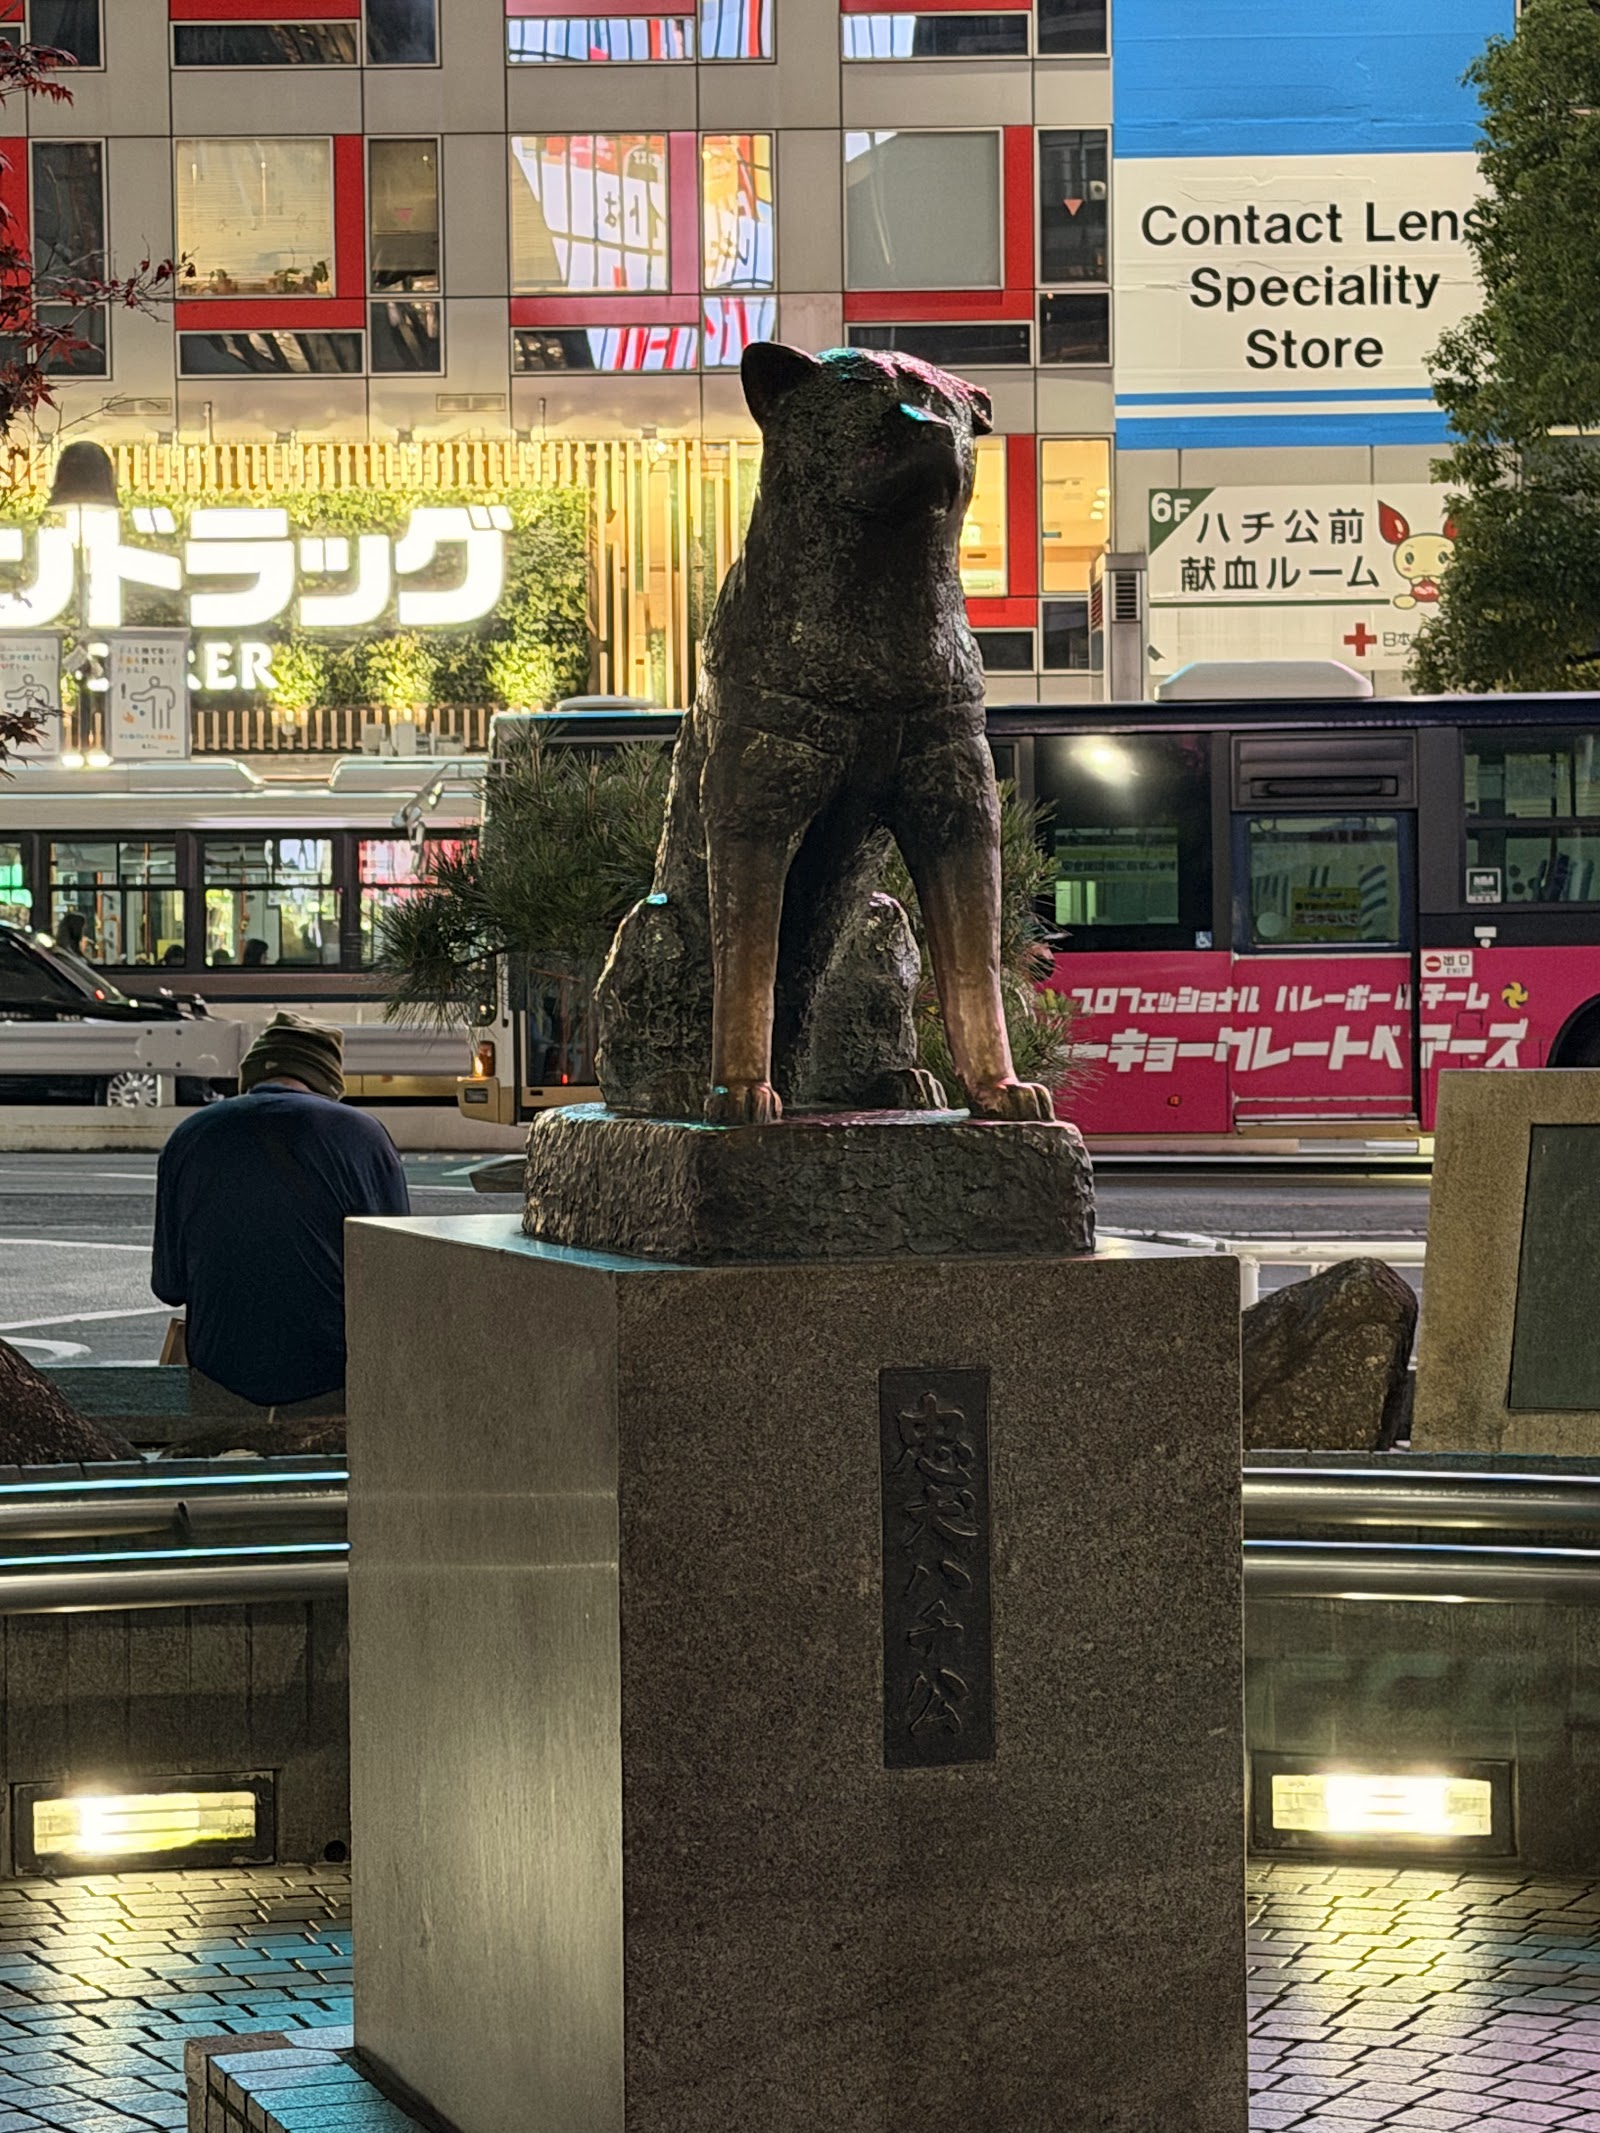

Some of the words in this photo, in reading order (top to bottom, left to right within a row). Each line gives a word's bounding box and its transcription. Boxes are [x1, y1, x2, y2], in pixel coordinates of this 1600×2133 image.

[1141, 204, 1343, 246] Contact
[1190, 266, 1440, 313] Speciality
[1246, 329, 1384, 369] Store
[1151, 492, 1191, 523] 6F
[1196, 508, 1366, 545] ハチ公前
[1180, 555, 1380, 592] 献血ルーム
[1443, 955, 1470, 966] 出口
